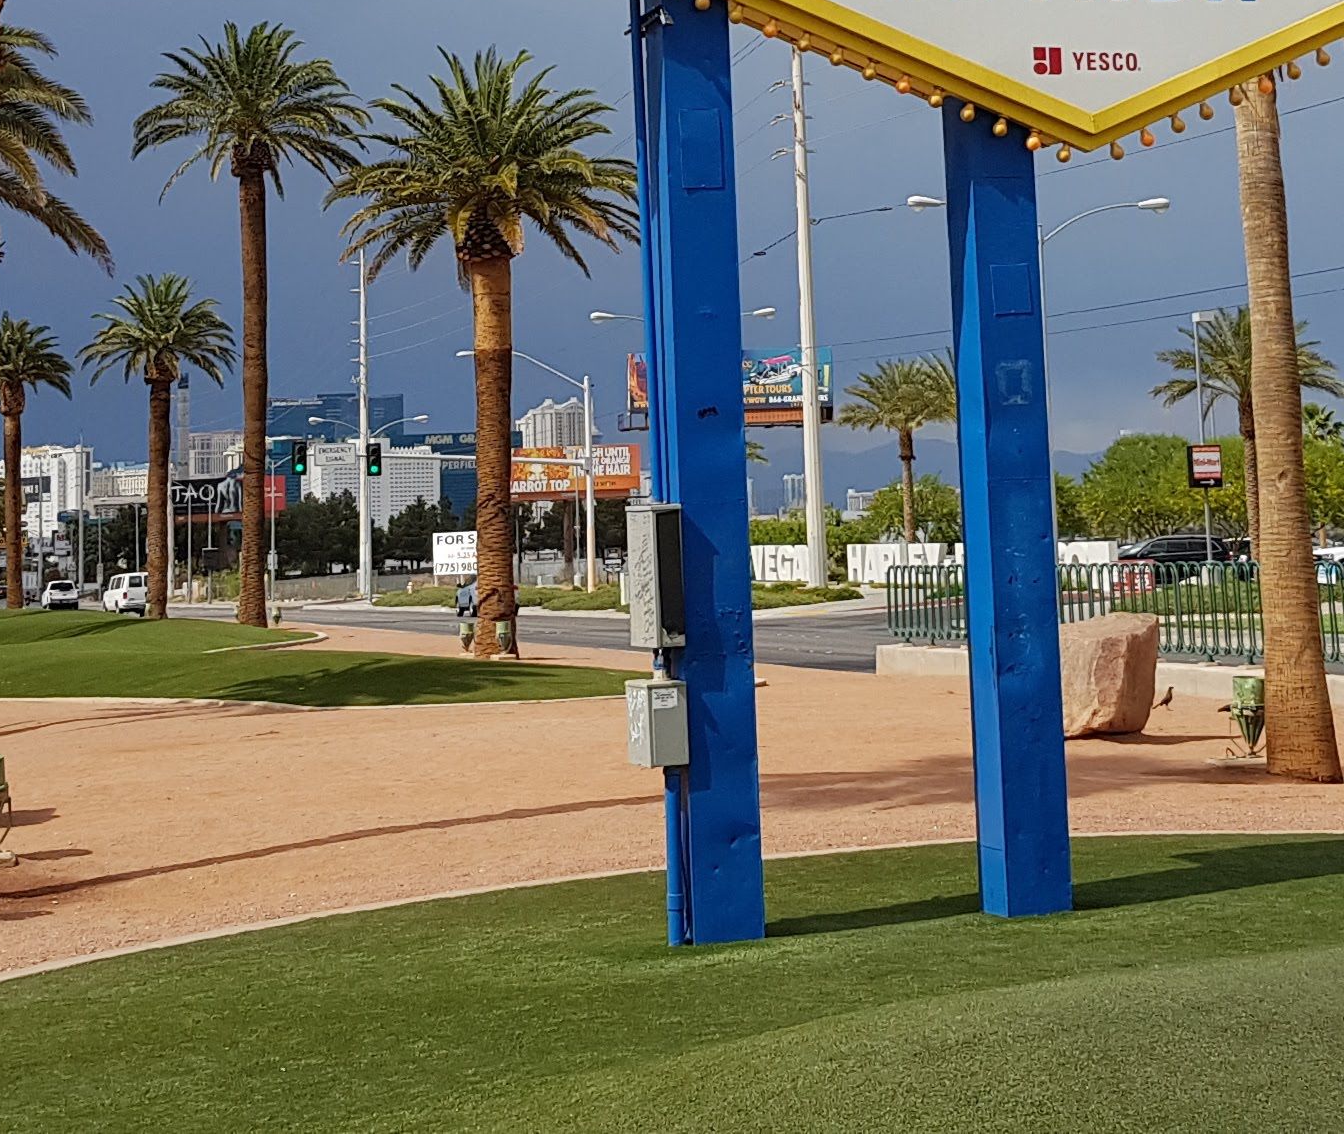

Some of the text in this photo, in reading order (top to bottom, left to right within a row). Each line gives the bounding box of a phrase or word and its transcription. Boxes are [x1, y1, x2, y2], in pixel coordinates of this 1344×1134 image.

[424, 434, 454, 445] MGM
[510, 479, 570, 493] ARROT TOP
[171, 482, 216, 503] TAO
[437, 534, 464, 545] FOR
[435, 562, 459, 573] (775)
[750, 545, 808, 582] VEGA
